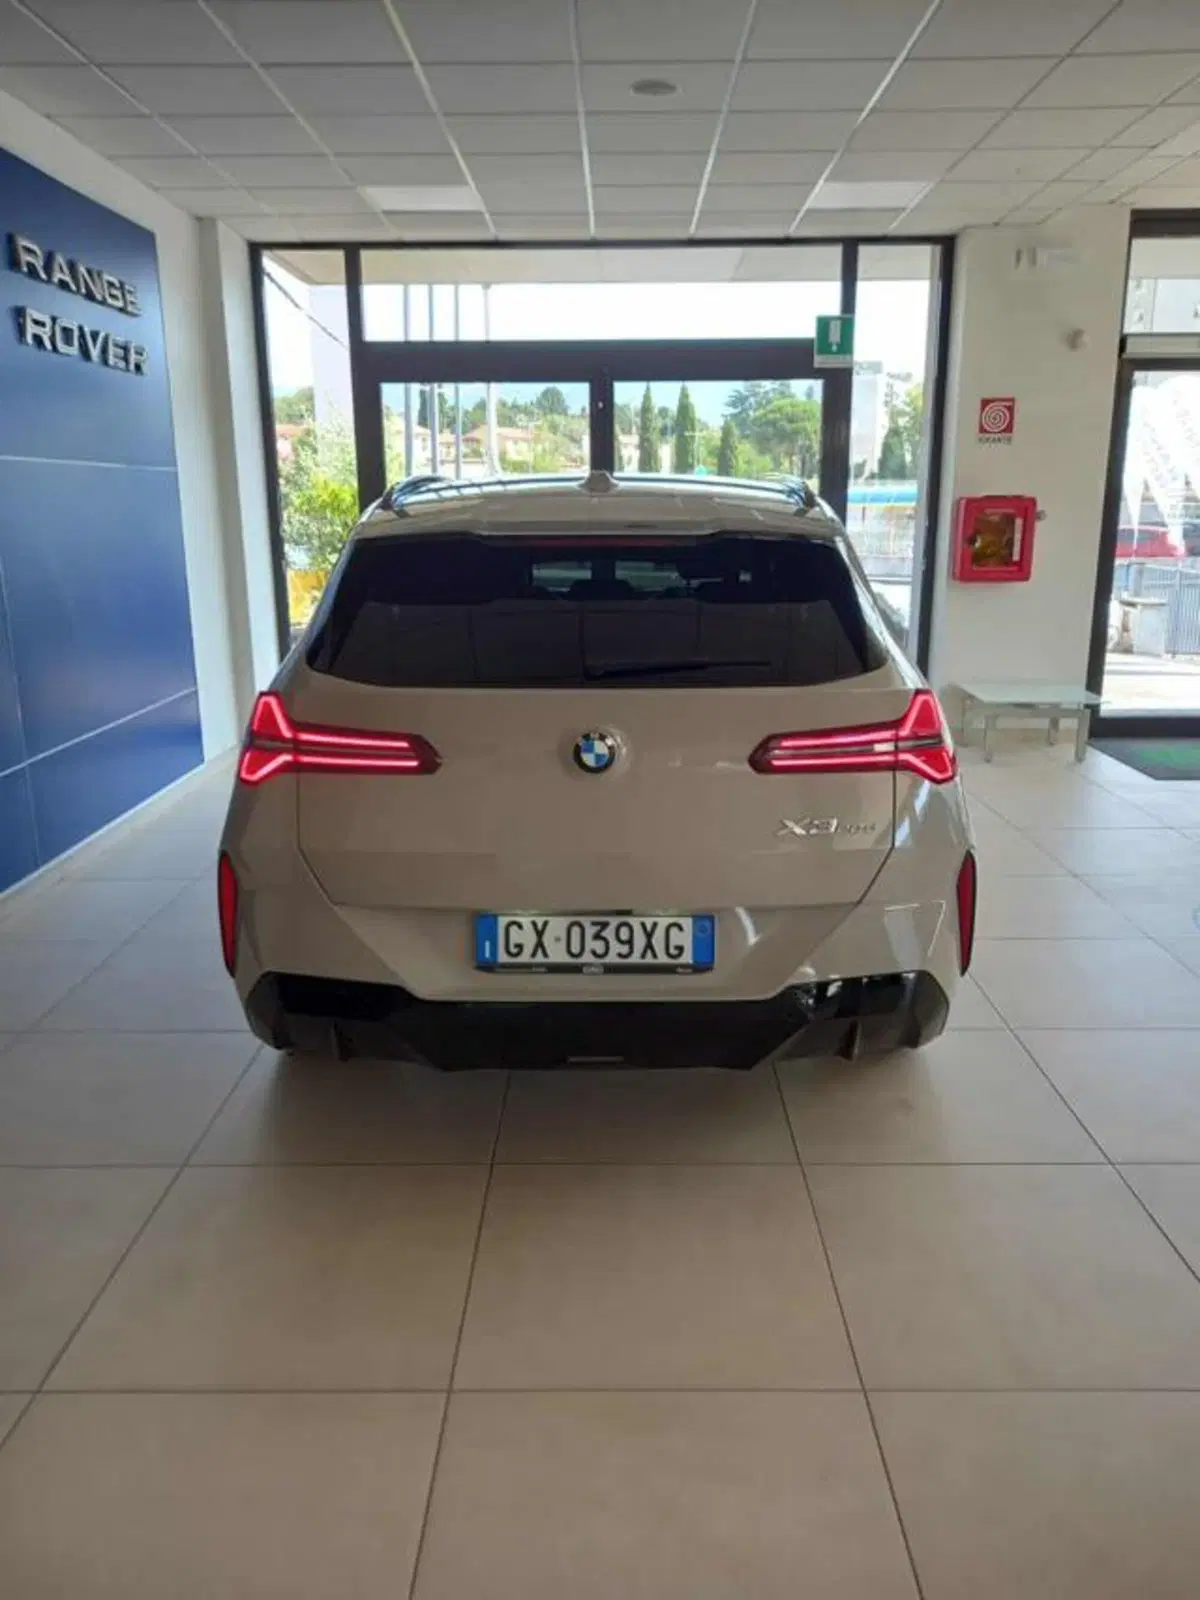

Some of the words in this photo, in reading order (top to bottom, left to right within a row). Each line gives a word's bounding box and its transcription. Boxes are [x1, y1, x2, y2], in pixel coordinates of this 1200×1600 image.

[10, 233, 143, 316] RANGE
[19, 306, 148, 375] ROVER
[504, 919, 550, 959] GX
[565, 920, 685, 960] 039XG
